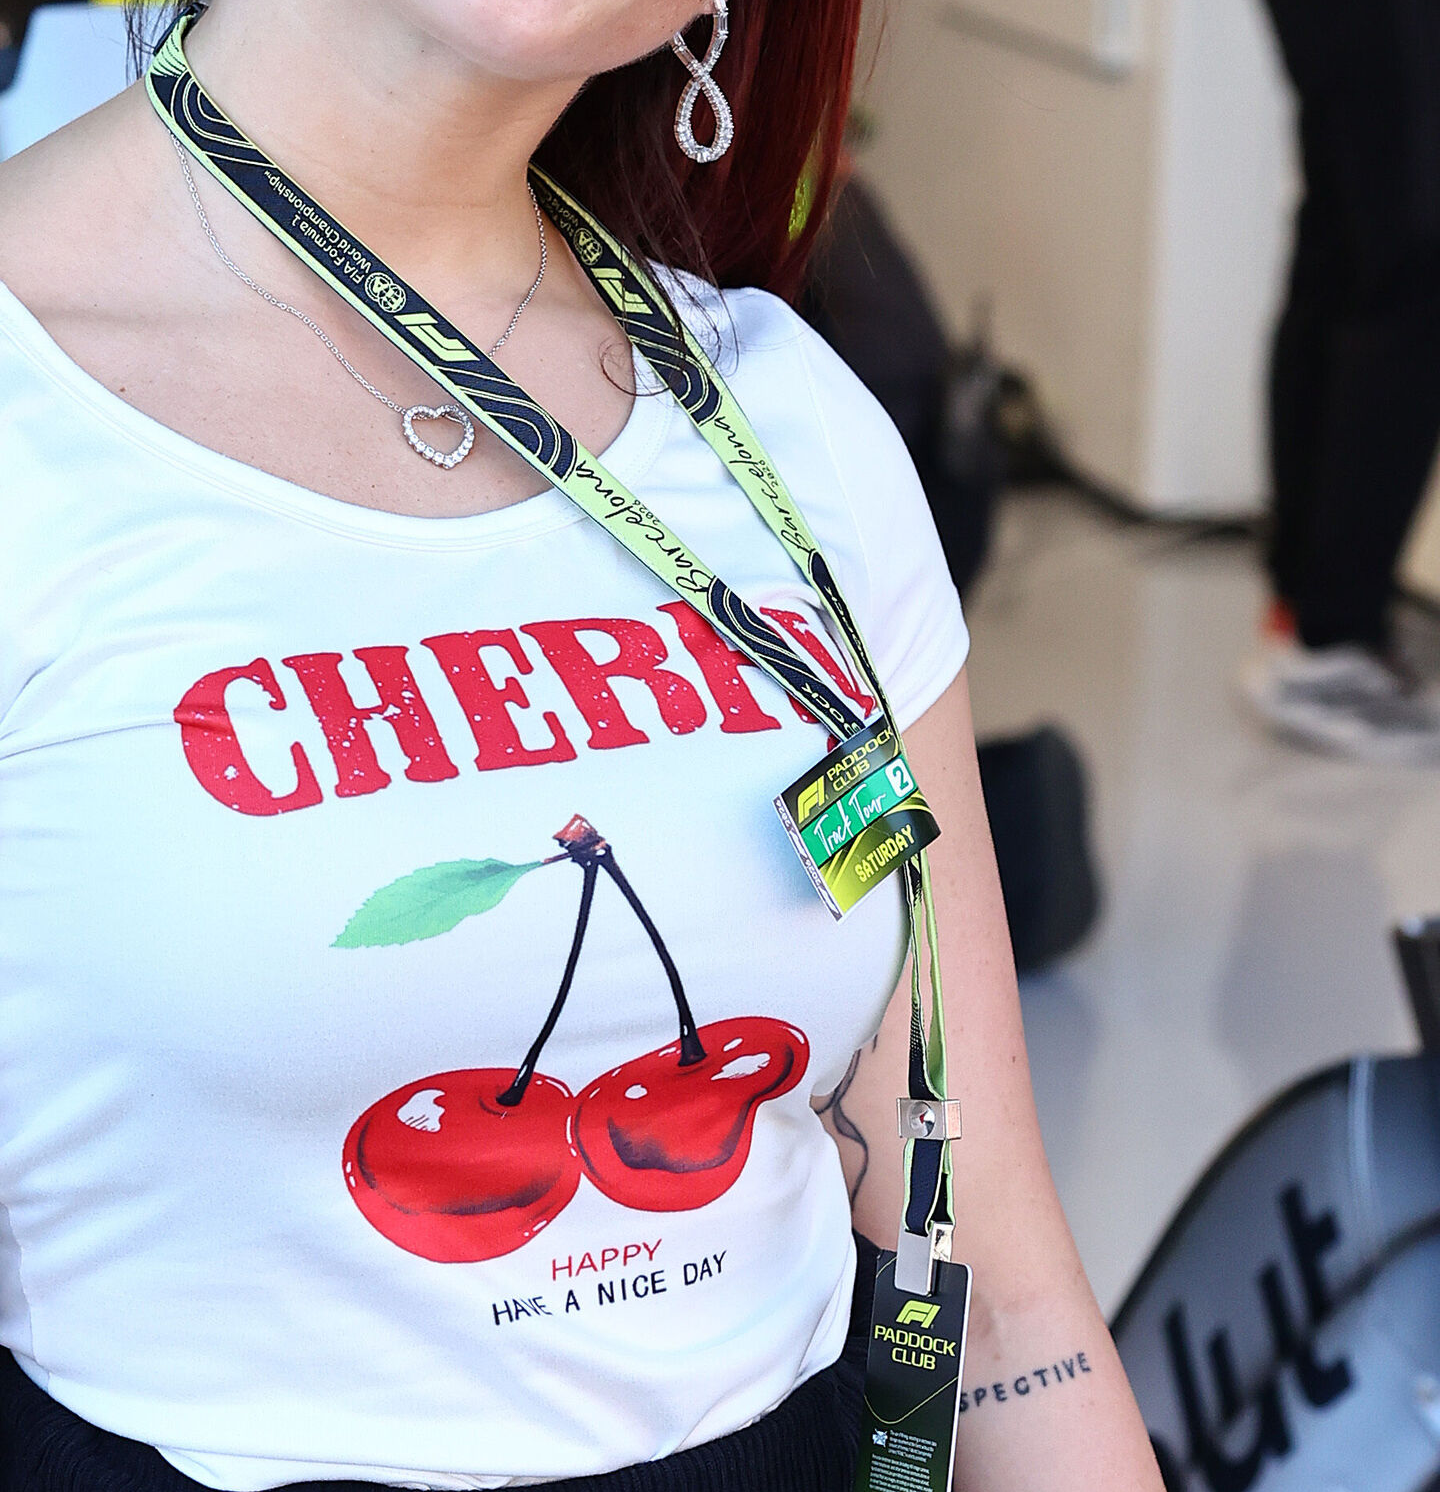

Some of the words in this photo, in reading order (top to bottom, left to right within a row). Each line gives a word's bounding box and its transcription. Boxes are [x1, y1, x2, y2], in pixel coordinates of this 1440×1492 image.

[299, 222, 345, 266] Formula
[339, 238, 372, 272] World
[342, 261, 365, 284] FIA
[714, 416, 811, 552] Barcelona
[575, 460, 714, 593] Barcelona
[632, 498, 660, 526] 2026
[826, 728, 894, 781] PADDOCK
[832, 759, 871, 792] CLUB
[892, 765, 909, 791] 2
[813, 798, 854, 857] Track
[848, 782, 887, 828] Tour
[854, 823, 916, 884] SATURDAY
[551, 1238, 662, 1282] HAPPY
[491, 1295, 553, 1326] HAVE
[564, 1289, 581, 1313] A
[597, 1269, 667, 1306] NICE
[683, 1250, 727, 1286] DAY
[873, 1324, 957, 1357] PADDOCK
[891, 1346, 937, 1371] CLUB
